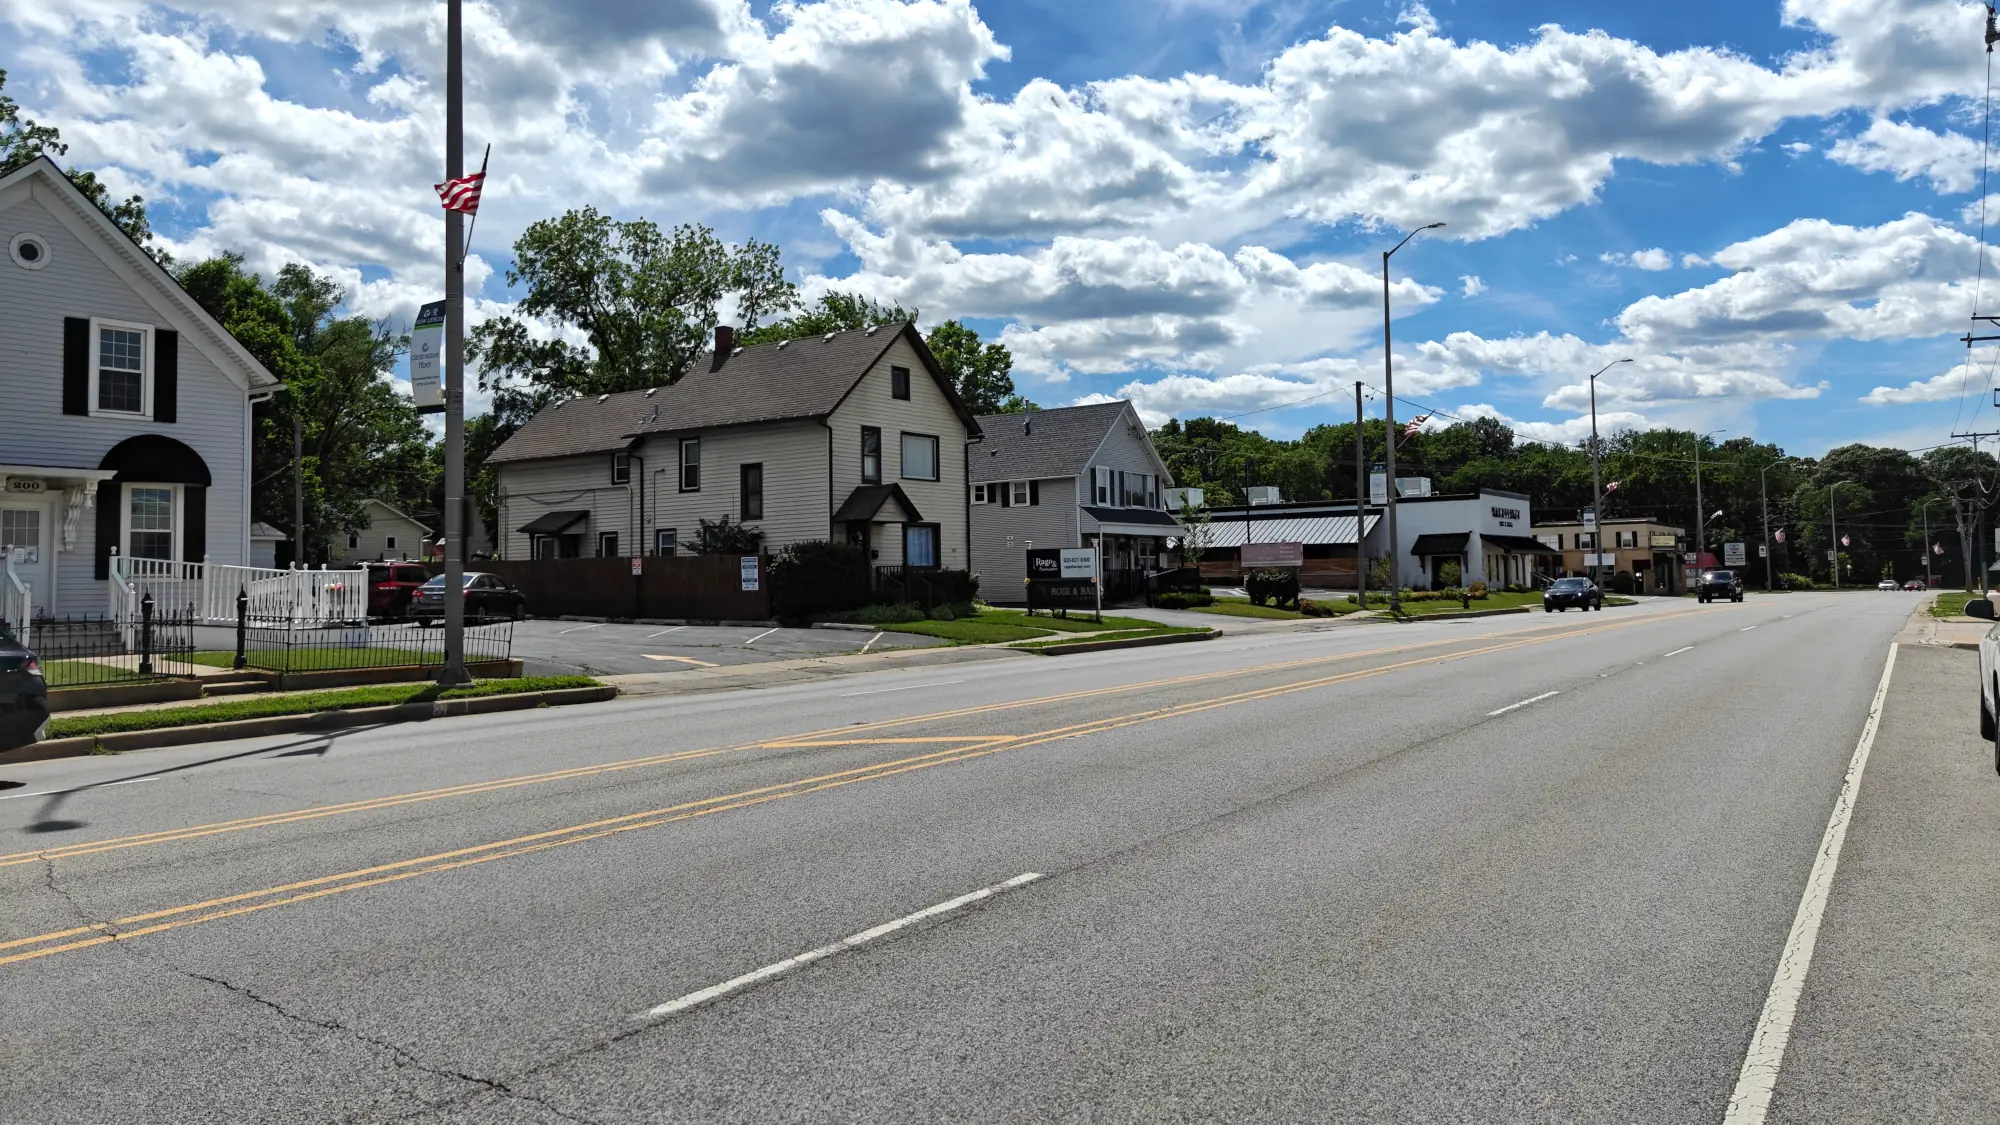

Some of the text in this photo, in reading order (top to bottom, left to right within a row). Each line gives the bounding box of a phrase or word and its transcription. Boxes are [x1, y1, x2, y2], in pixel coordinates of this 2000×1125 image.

[418, 361, 432, 369] fiber
[13, 482, 40, 490] 200
[1035, 557, 1053, 568] Rago
